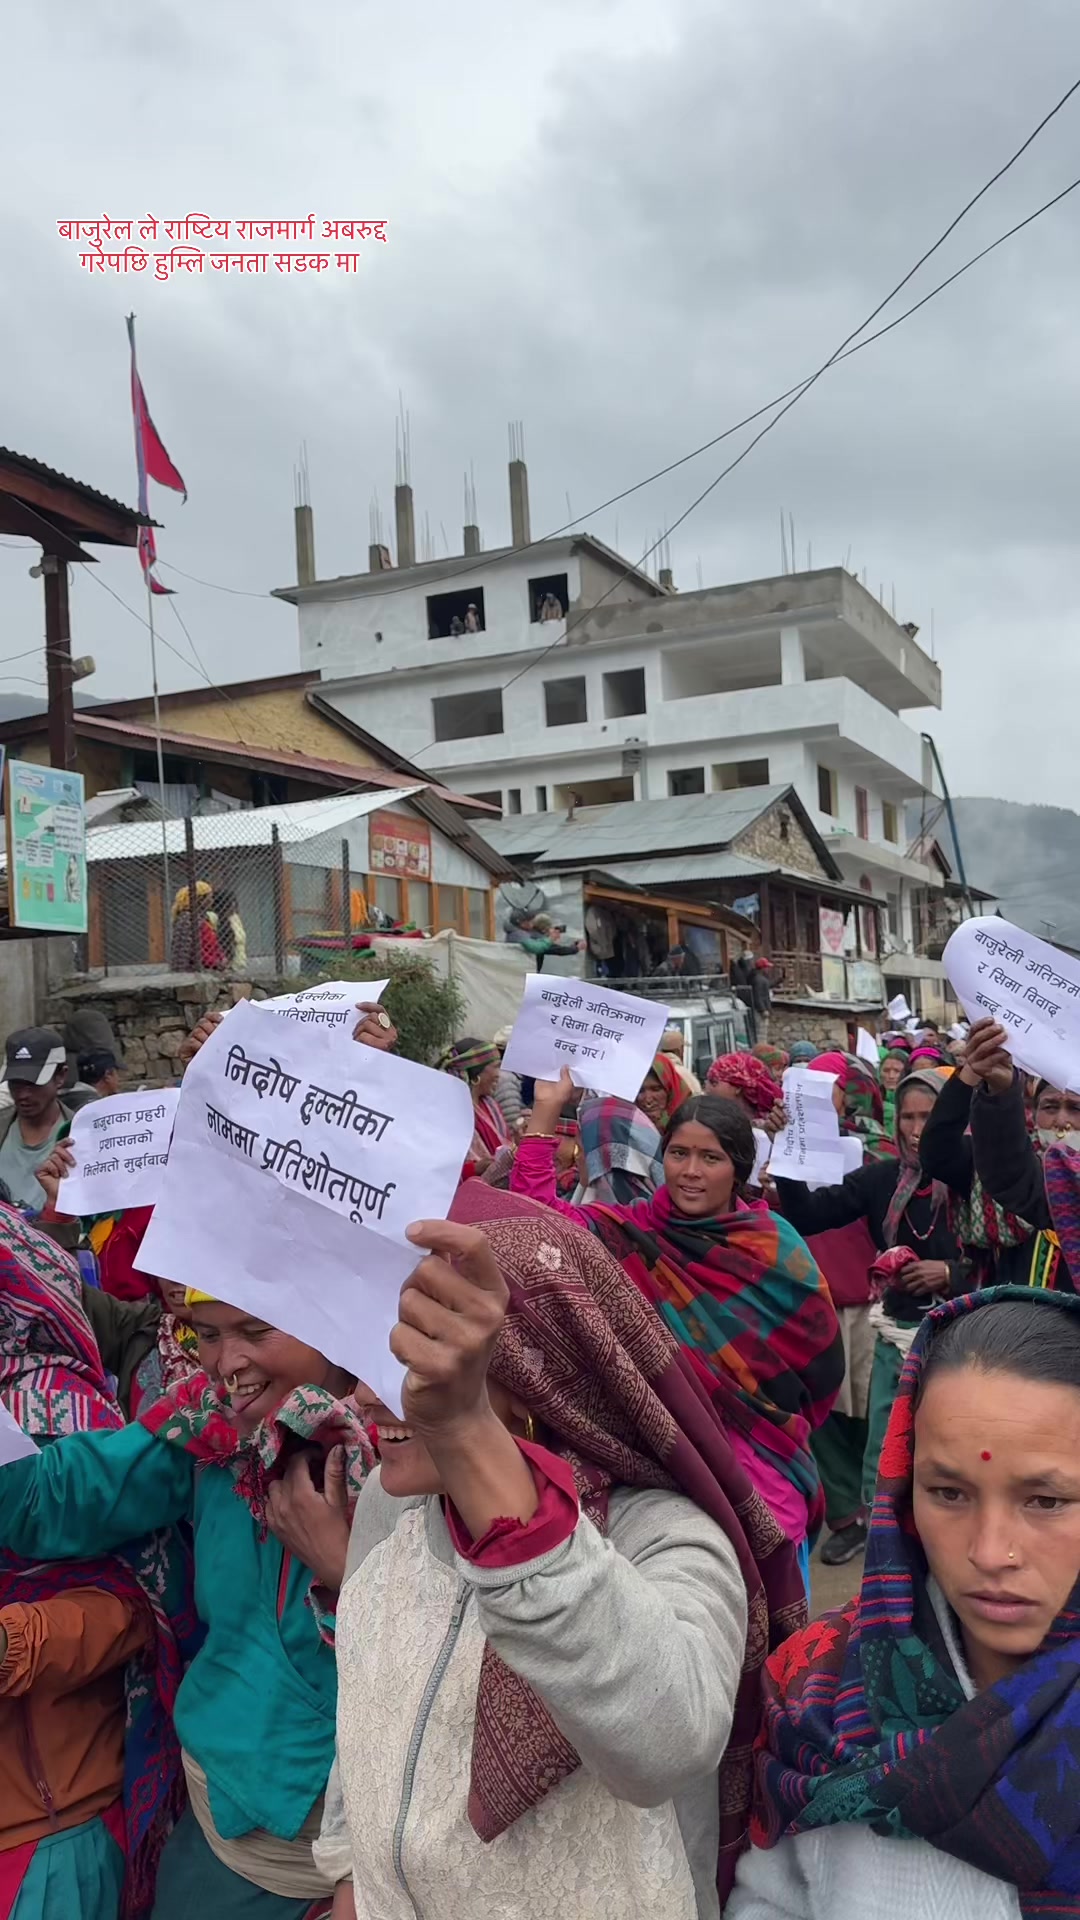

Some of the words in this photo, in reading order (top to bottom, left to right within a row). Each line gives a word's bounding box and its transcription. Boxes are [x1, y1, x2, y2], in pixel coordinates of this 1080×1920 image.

[977, 961, 989, 974] र
[989, 968, 1023, 993] सिमा
[1025, 960, 1080, 999] अतिक्रम
[550, 1014, 559, 1026] र
[561, 1015, 589, 1032] सिमा
[586, 1001, 647, 1026] अतिक्रमण
[134, 1105, 166, 1123] प्रहरी
[300, 1083, 395, 1142] हुम्लीका
[98, 1130, 153, 1152] प्रशासनको
[206, 1102, 260, 1158] नाममा
